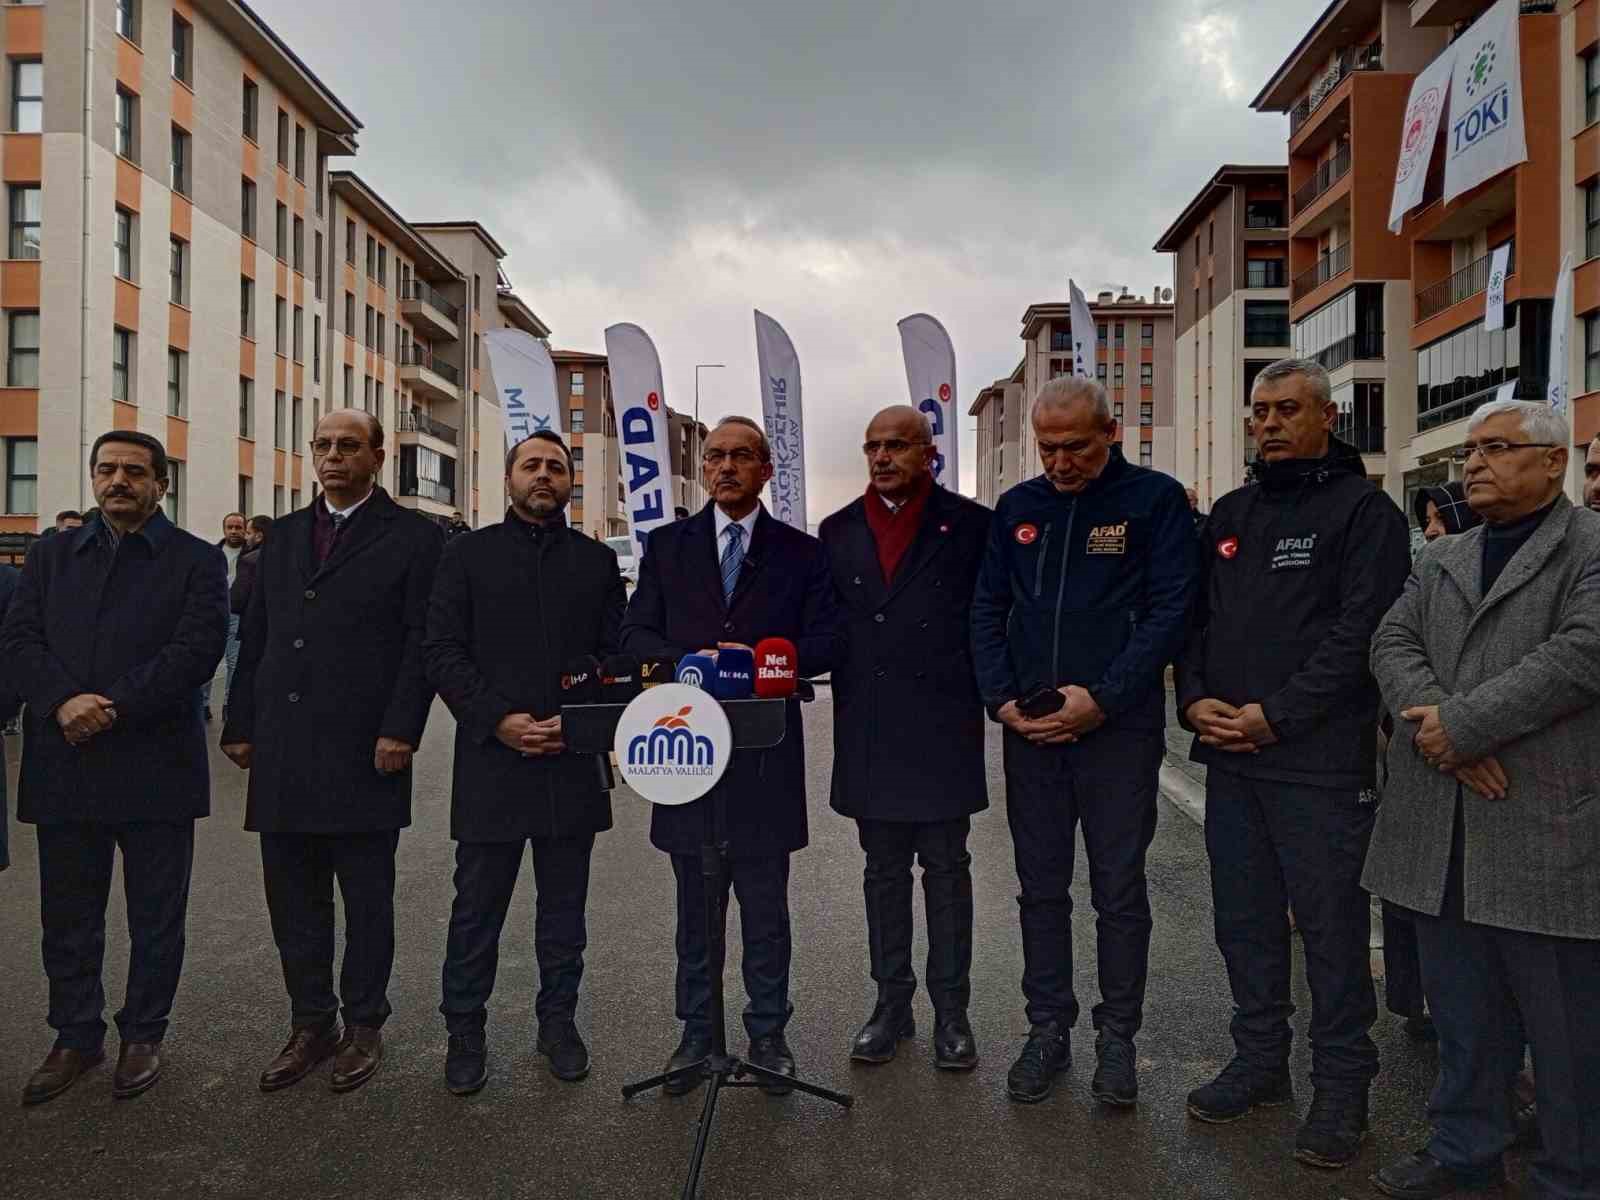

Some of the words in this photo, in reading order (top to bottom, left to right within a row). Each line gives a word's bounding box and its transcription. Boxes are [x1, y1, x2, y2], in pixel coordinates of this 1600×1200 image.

[1453, 88, 1508, 152] TOKİ
[1089, 524, 1126, 537] AFAD
[1275, 537, 1314, 552] AFAD
[765, 654, 788, 666] Net
[758, 666, 794, 679] Haber
[628, 767, 673, 776] MALATYA
